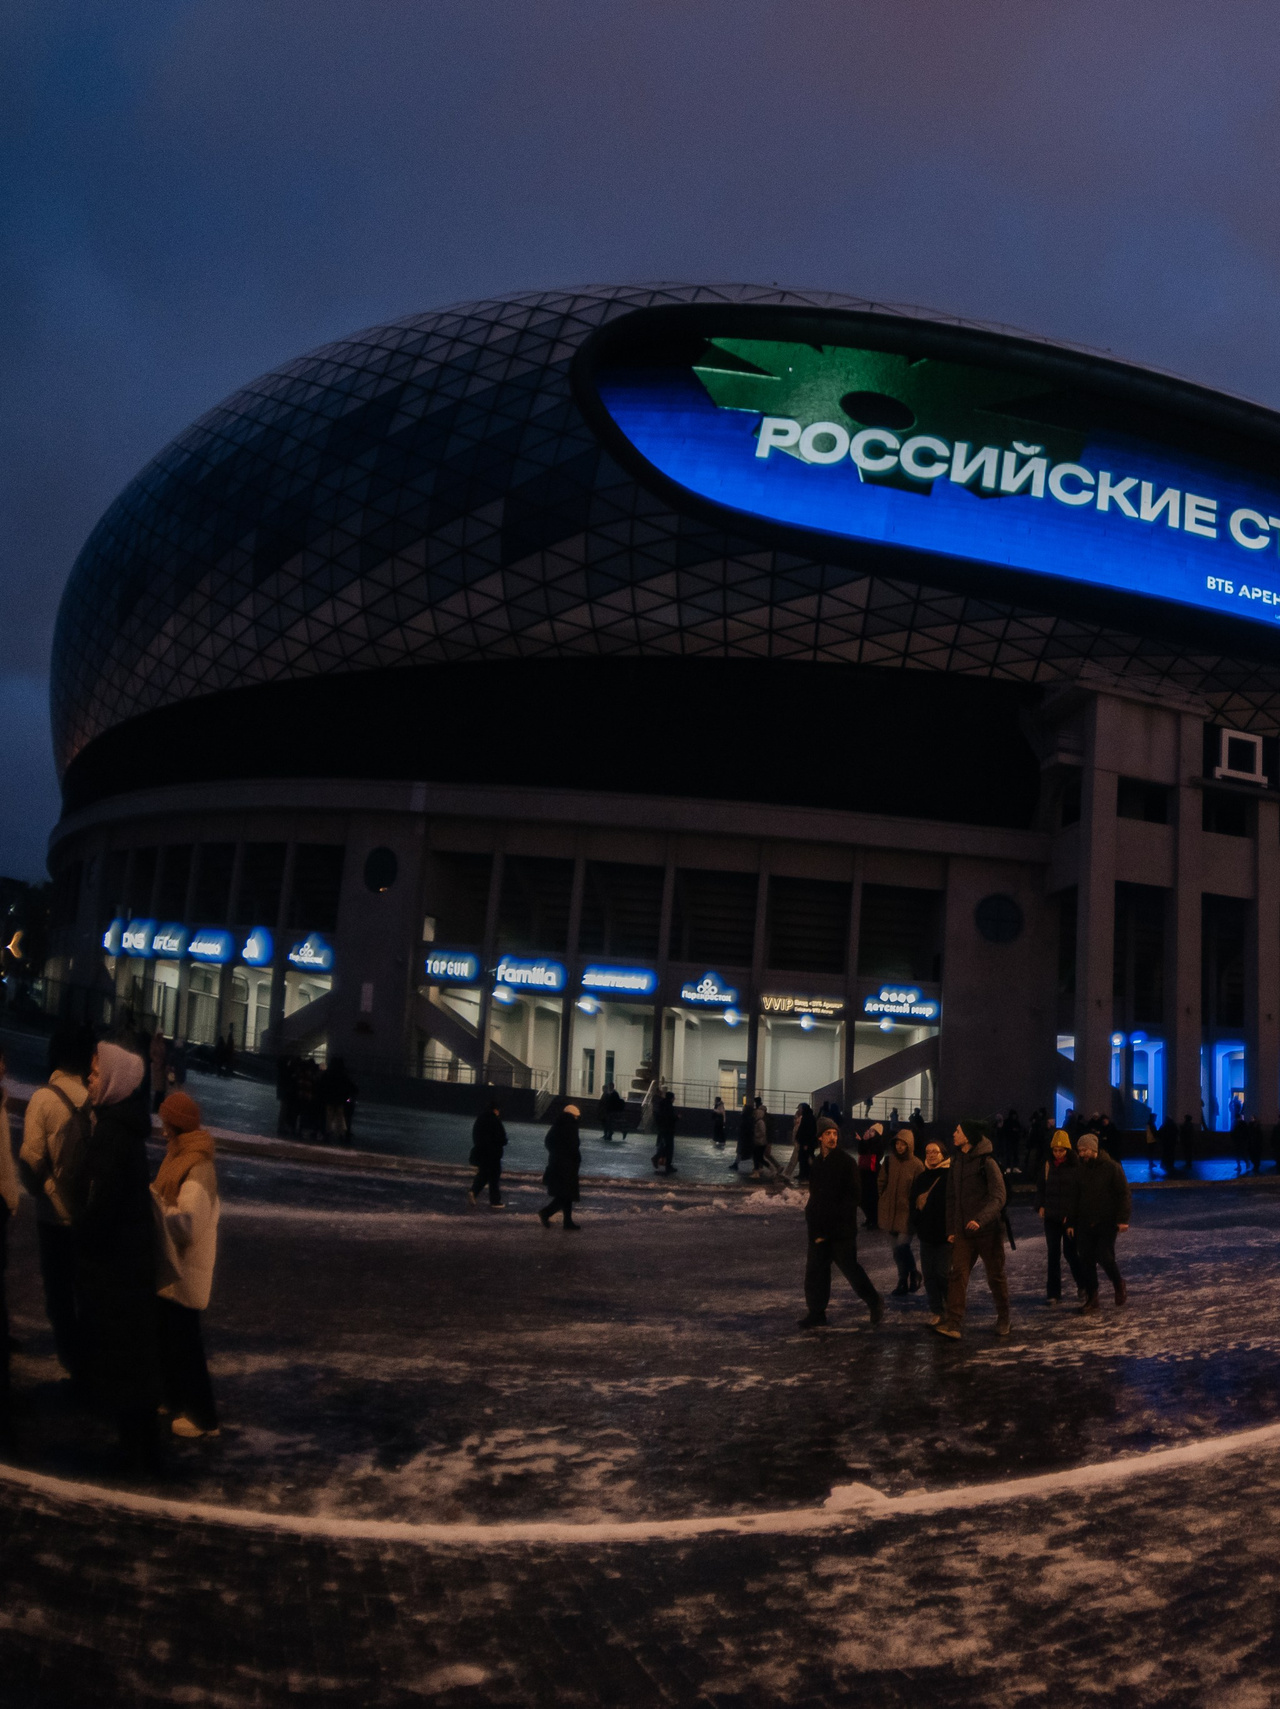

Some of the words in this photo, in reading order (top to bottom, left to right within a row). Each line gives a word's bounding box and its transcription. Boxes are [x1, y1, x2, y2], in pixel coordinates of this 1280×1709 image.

[755, 416, 1217, 538] РОССИЙСКИЕ
[1206, 575, 1234, 595] ВТБ
[123, 932, 145, 949] DNS
